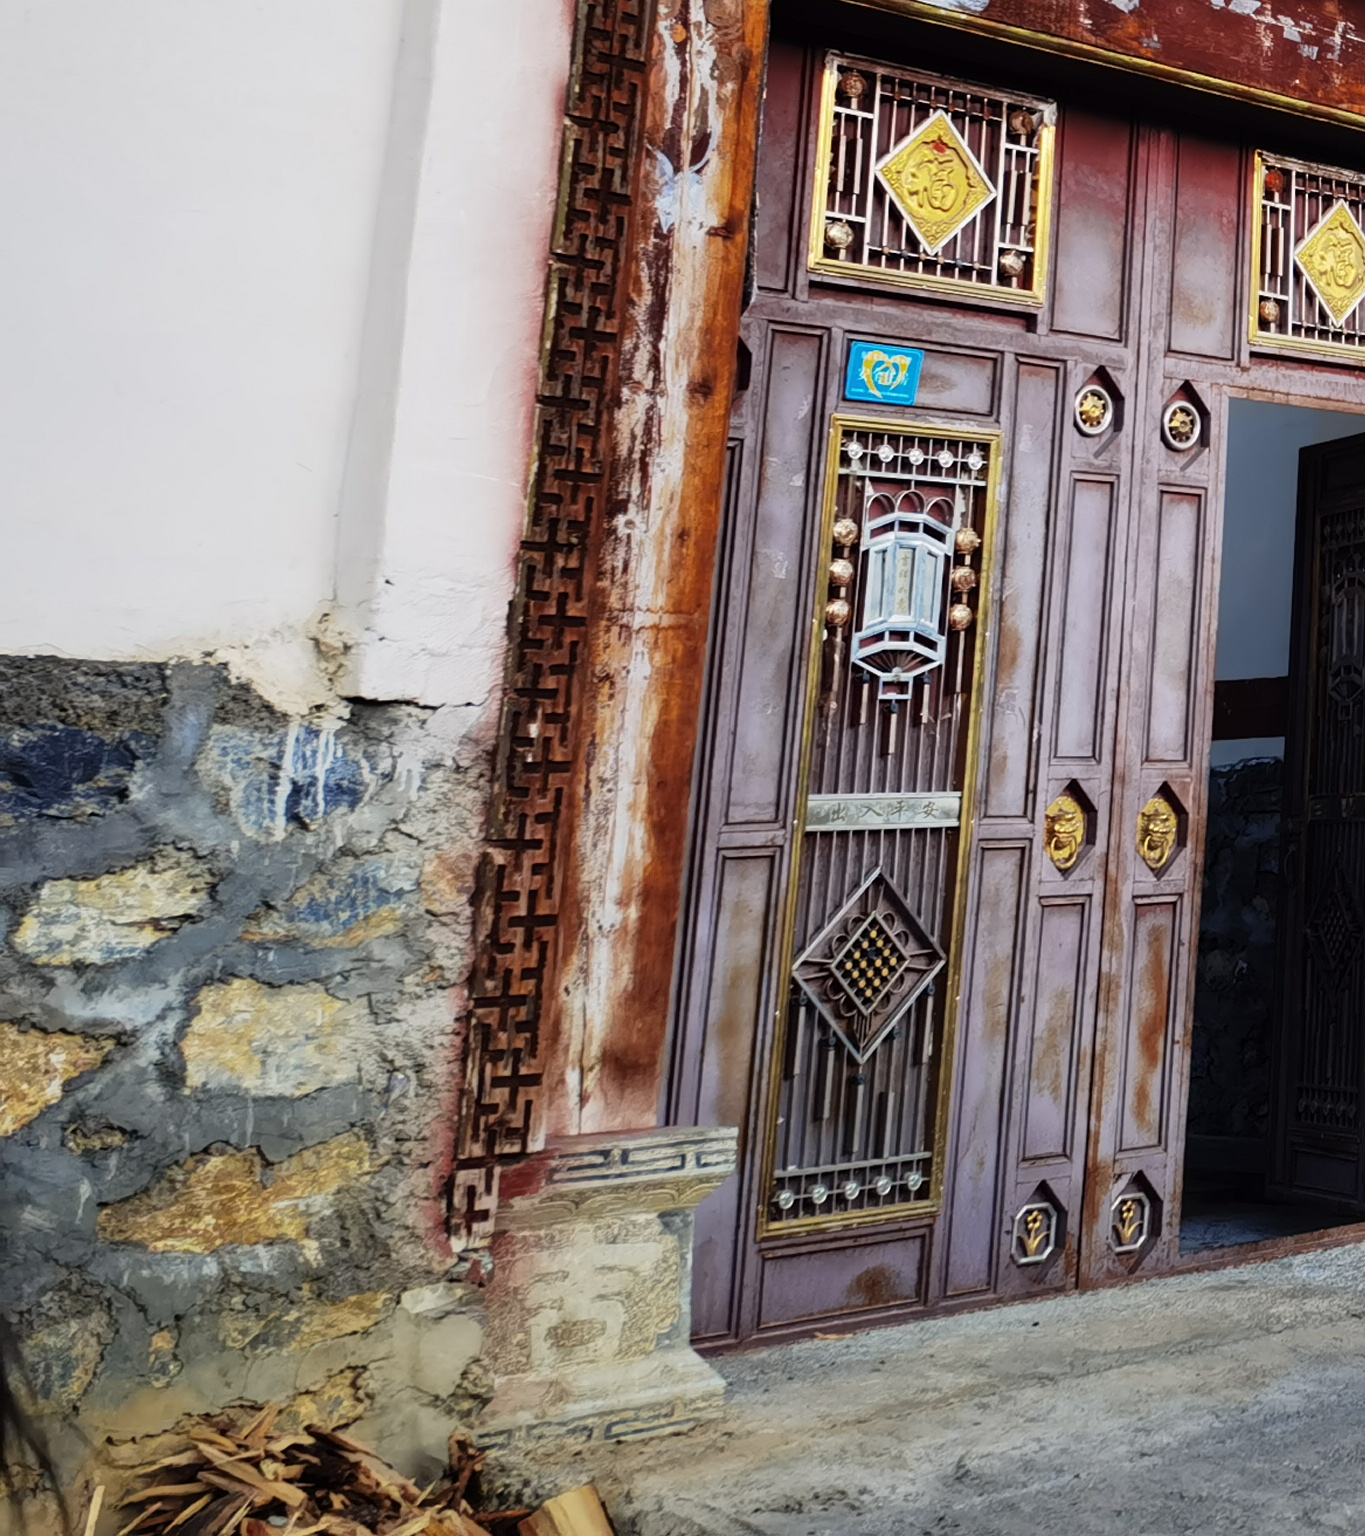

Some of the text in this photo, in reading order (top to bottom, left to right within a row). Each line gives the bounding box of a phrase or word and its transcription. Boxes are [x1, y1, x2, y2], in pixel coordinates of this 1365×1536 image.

[904, 152, 959, 213] 福
[1316, 237, 1358, 290] 福
[829, 799, 940, 823] 出入平安
